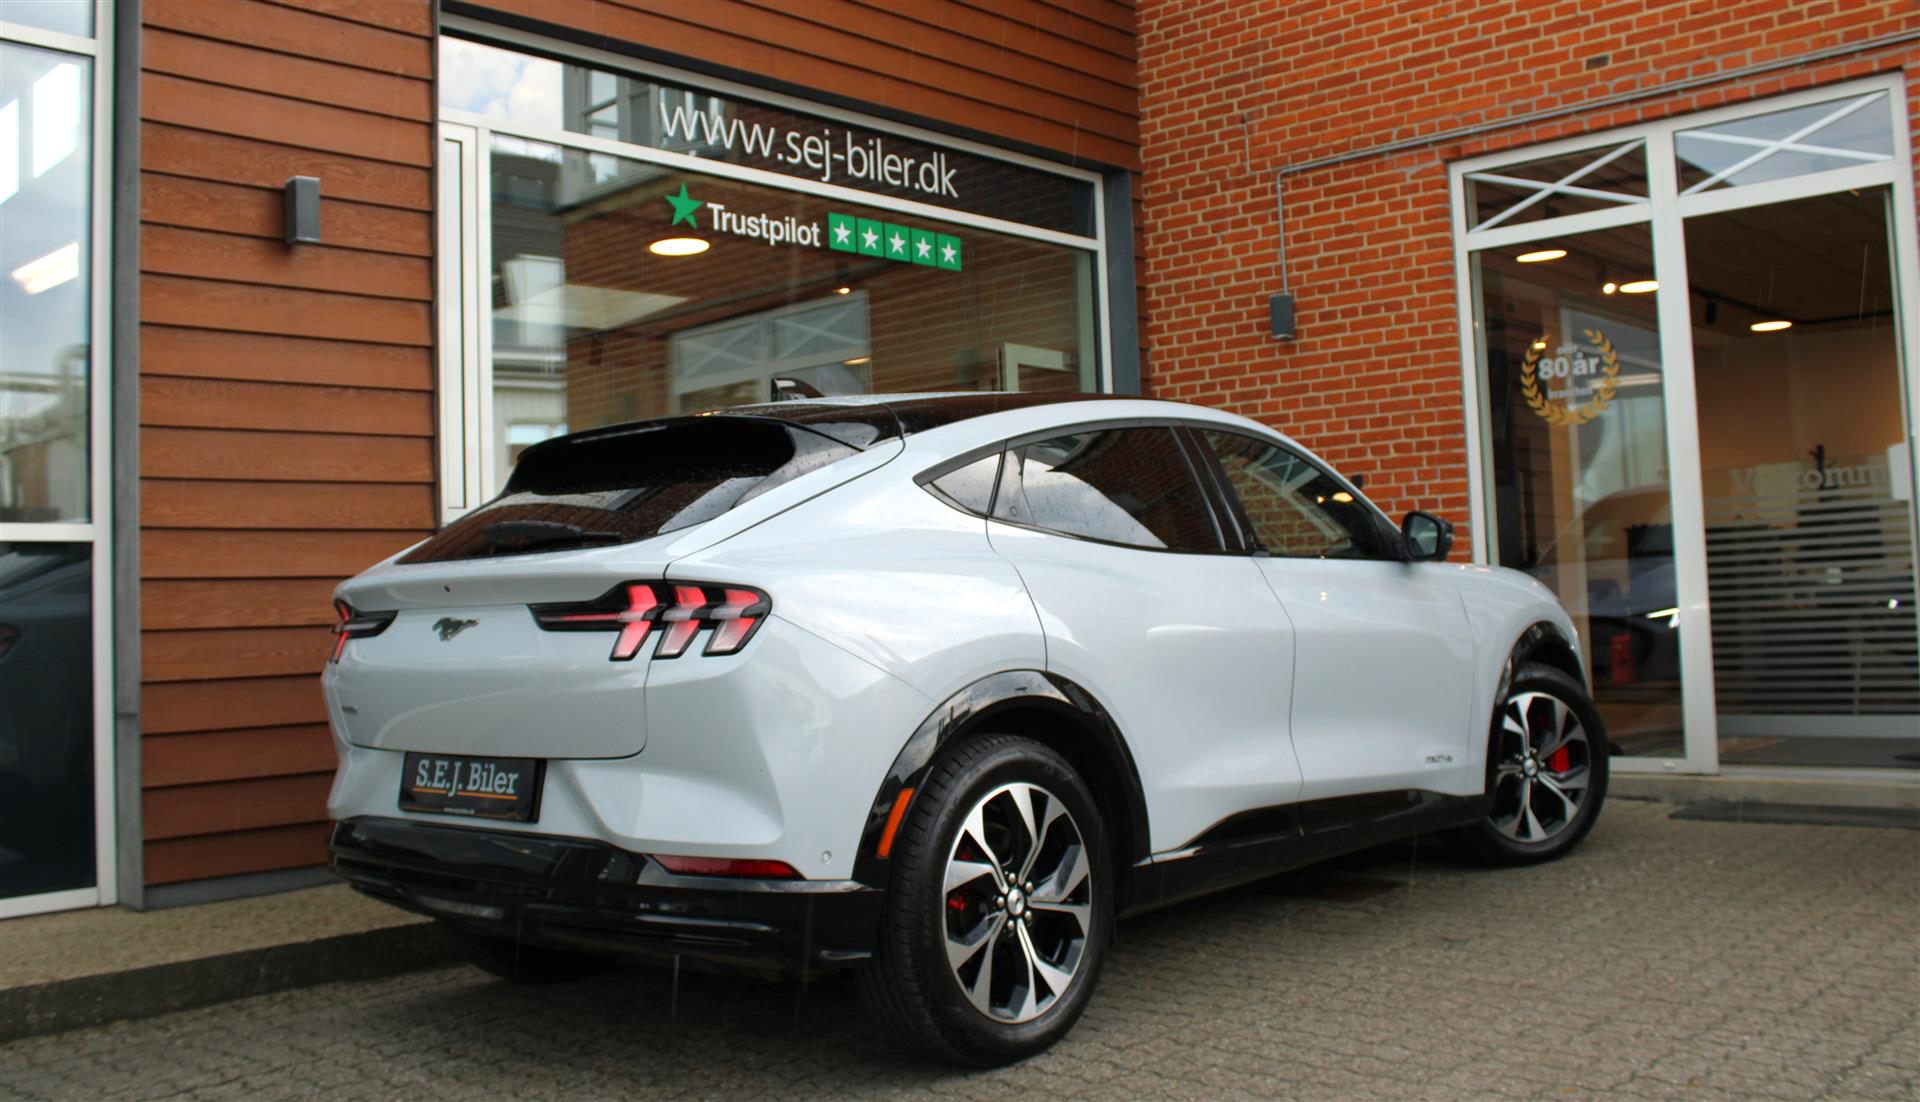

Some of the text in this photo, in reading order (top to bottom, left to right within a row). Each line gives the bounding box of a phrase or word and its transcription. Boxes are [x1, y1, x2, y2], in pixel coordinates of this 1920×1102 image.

[660, 102, 960, 199] www.sej-biler.dk
[706, 202, 821, 248] Trustpilot
[1538, 352, 1600, 380] 80 år
[415, 758, 519, 797] S.E.J. Biler
